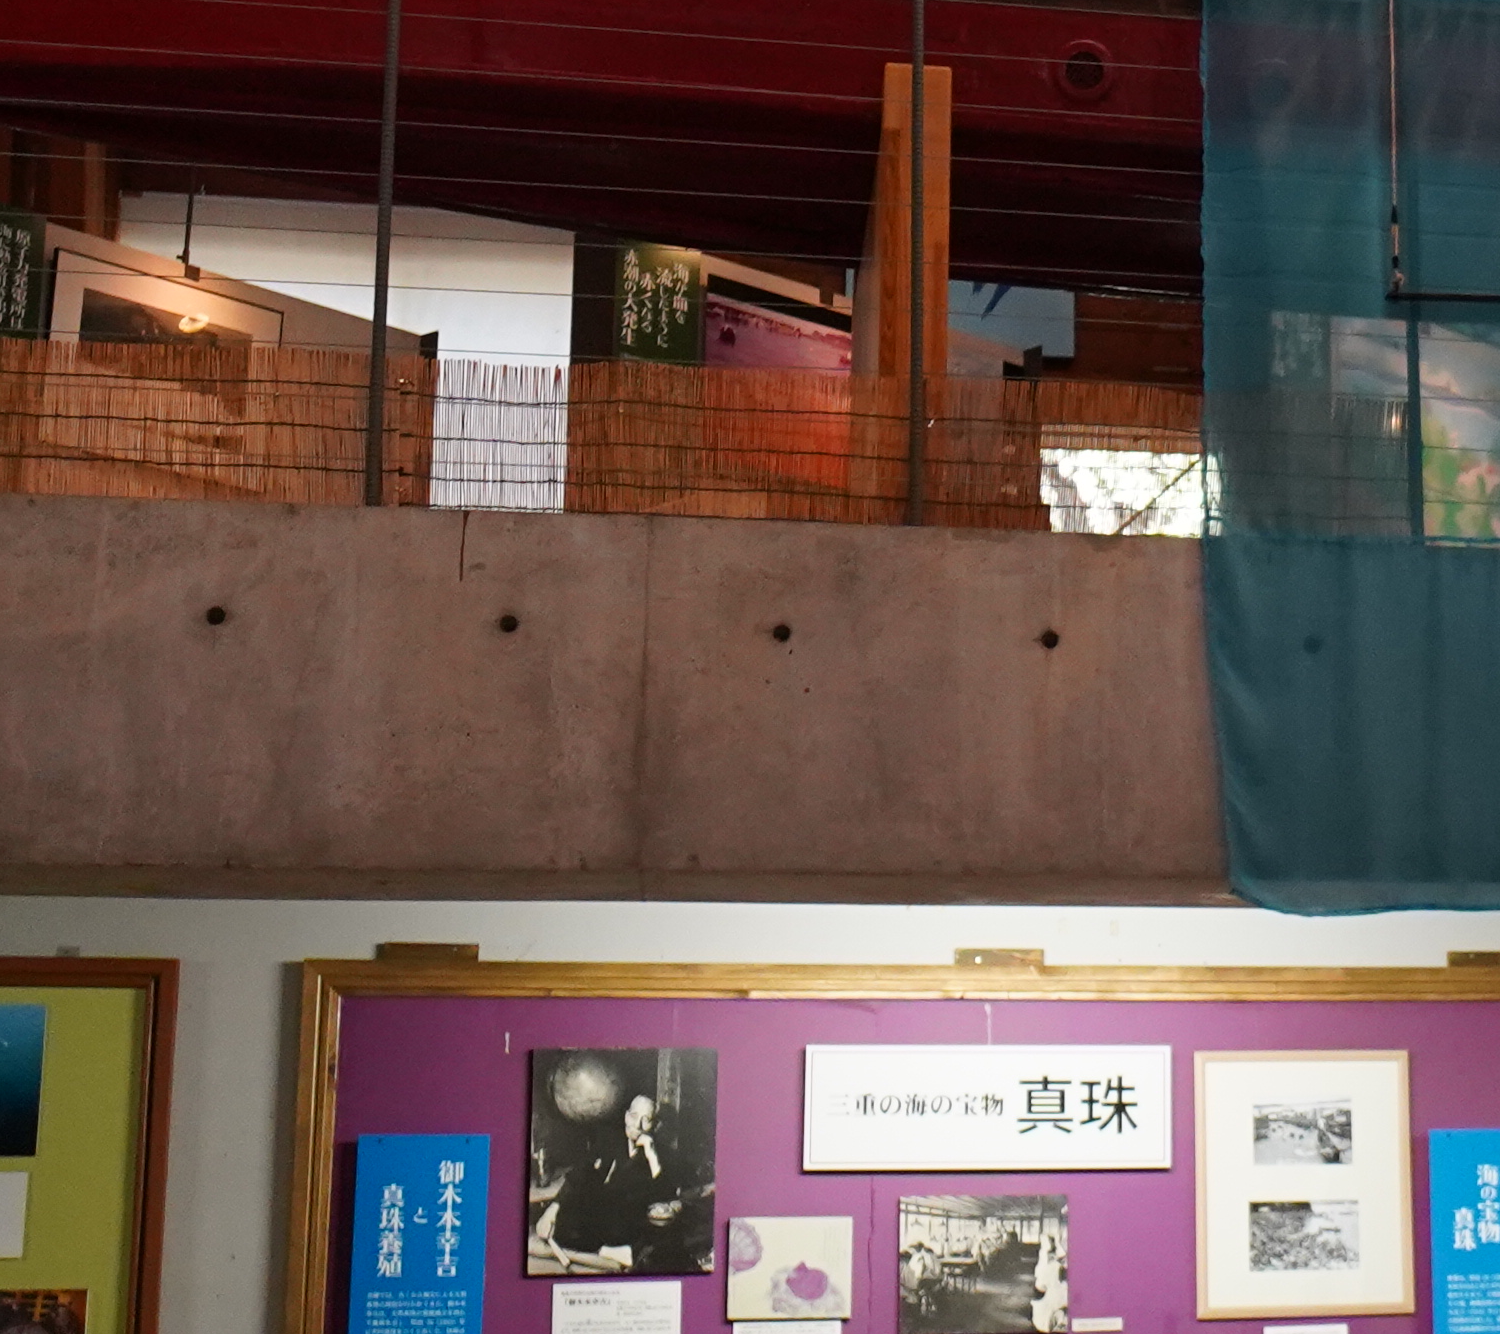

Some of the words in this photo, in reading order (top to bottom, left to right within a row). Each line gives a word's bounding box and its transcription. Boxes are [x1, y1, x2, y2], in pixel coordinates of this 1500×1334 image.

[619, 248, 639, 346] 赤潮の大発生
[639, 271, 656, 333] 赤くなる
[827, 1092, 1004, 1117] 三重の海の宝物
[1016, 1075, 1138, 1134] 真珠
[376, 1183, 405, 1278] 真珠養殖
[413, 1206, 428, 1224] と
[436, 1160, 465, 1278] 御木本幸吉
[1453, 1207, 1477, 1251] 真珠
